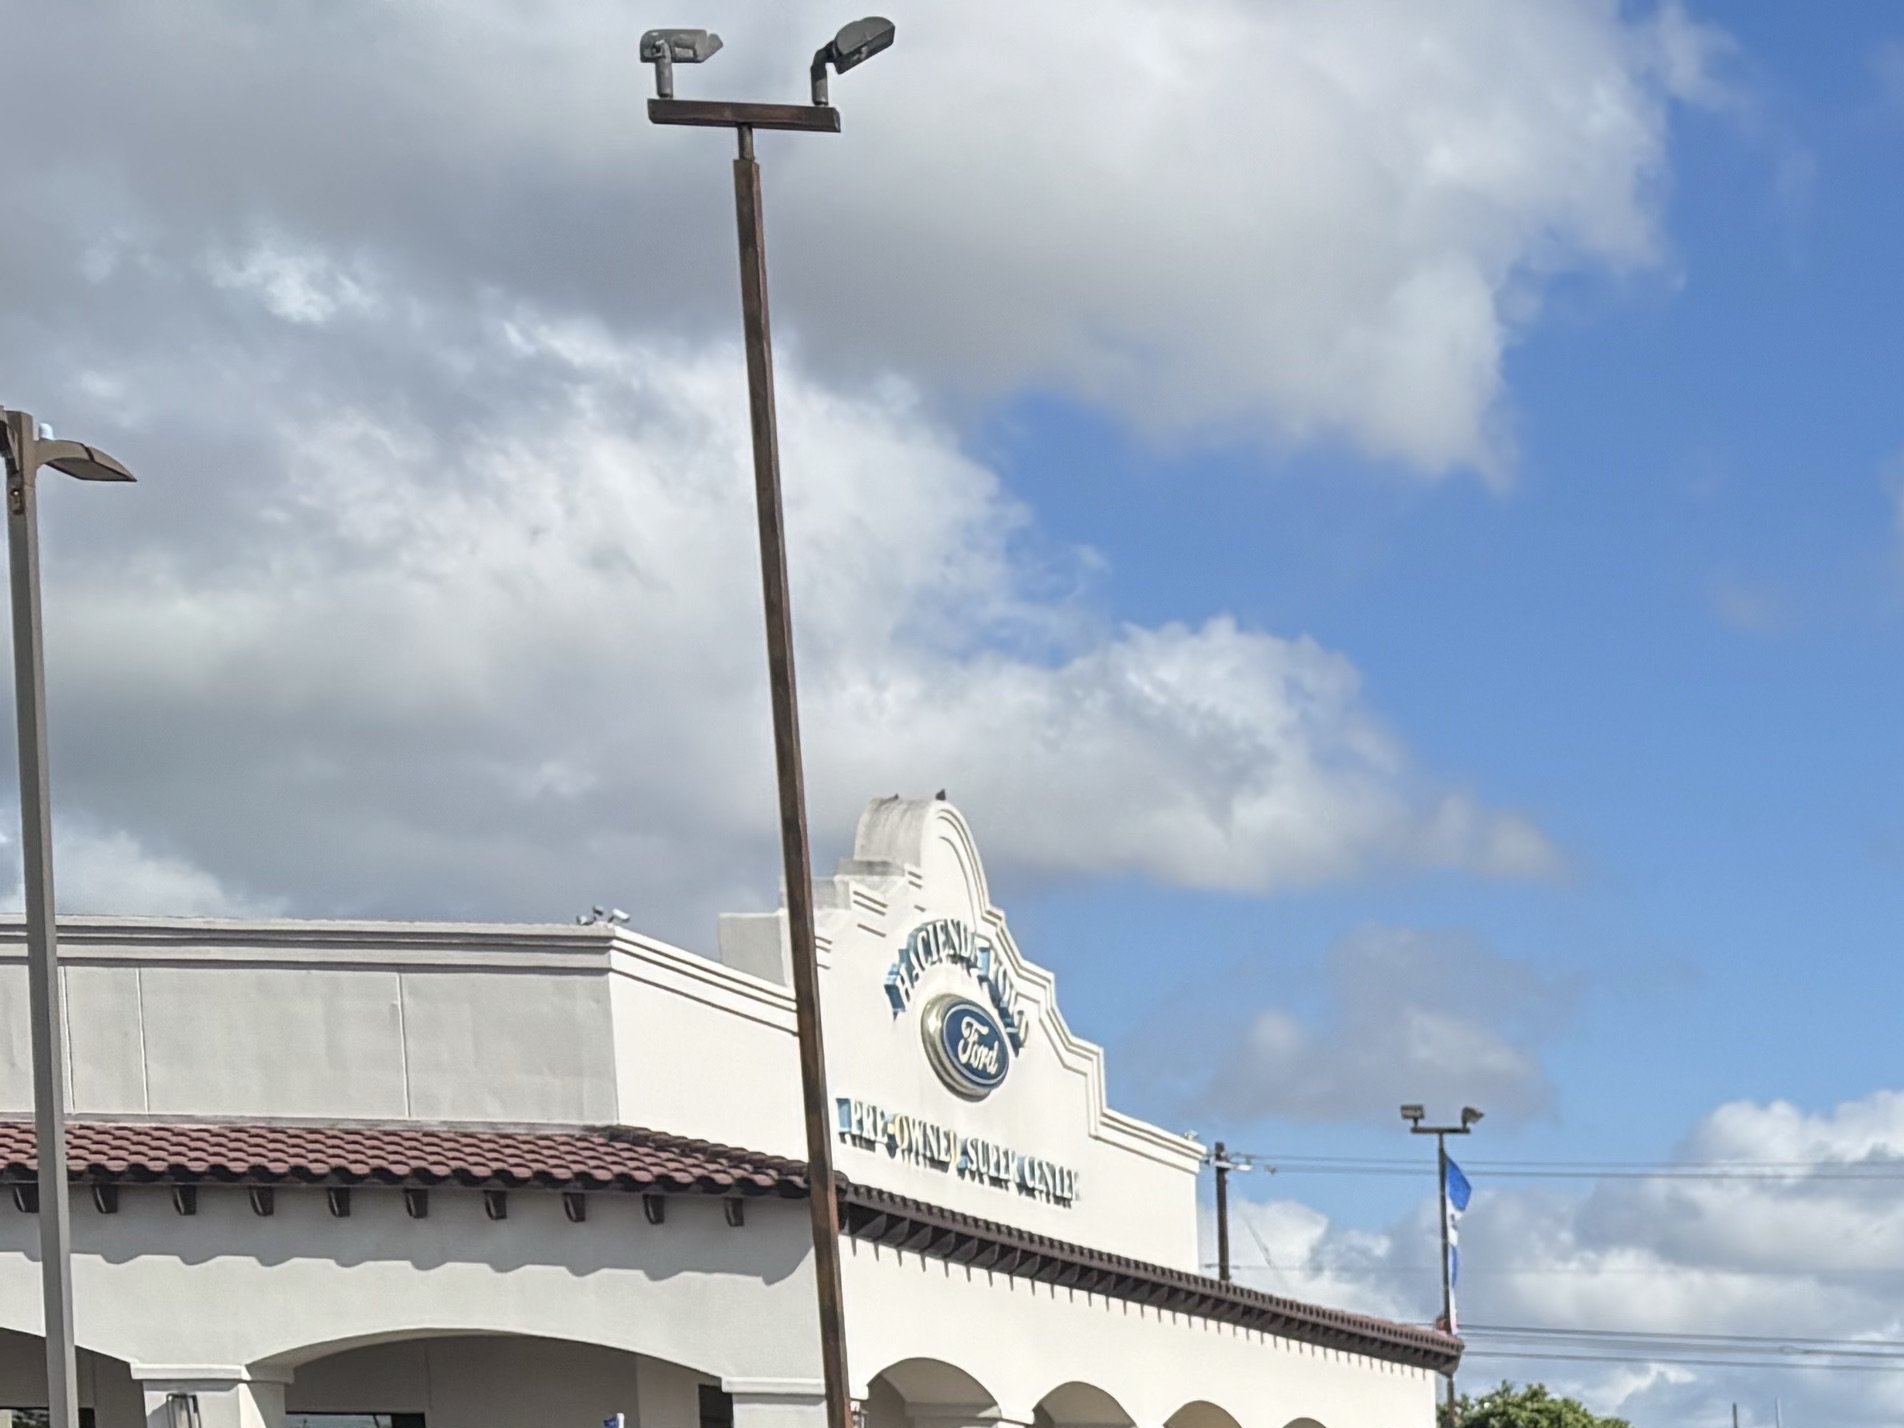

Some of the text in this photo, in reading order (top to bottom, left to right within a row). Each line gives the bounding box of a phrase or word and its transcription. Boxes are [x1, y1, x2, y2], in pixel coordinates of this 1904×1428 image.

[886, 919, 979, 1014] HACIENDA
[957, 1015, 999, 1076] Ford
[960, 1137, 1019, 1184] SUPER
